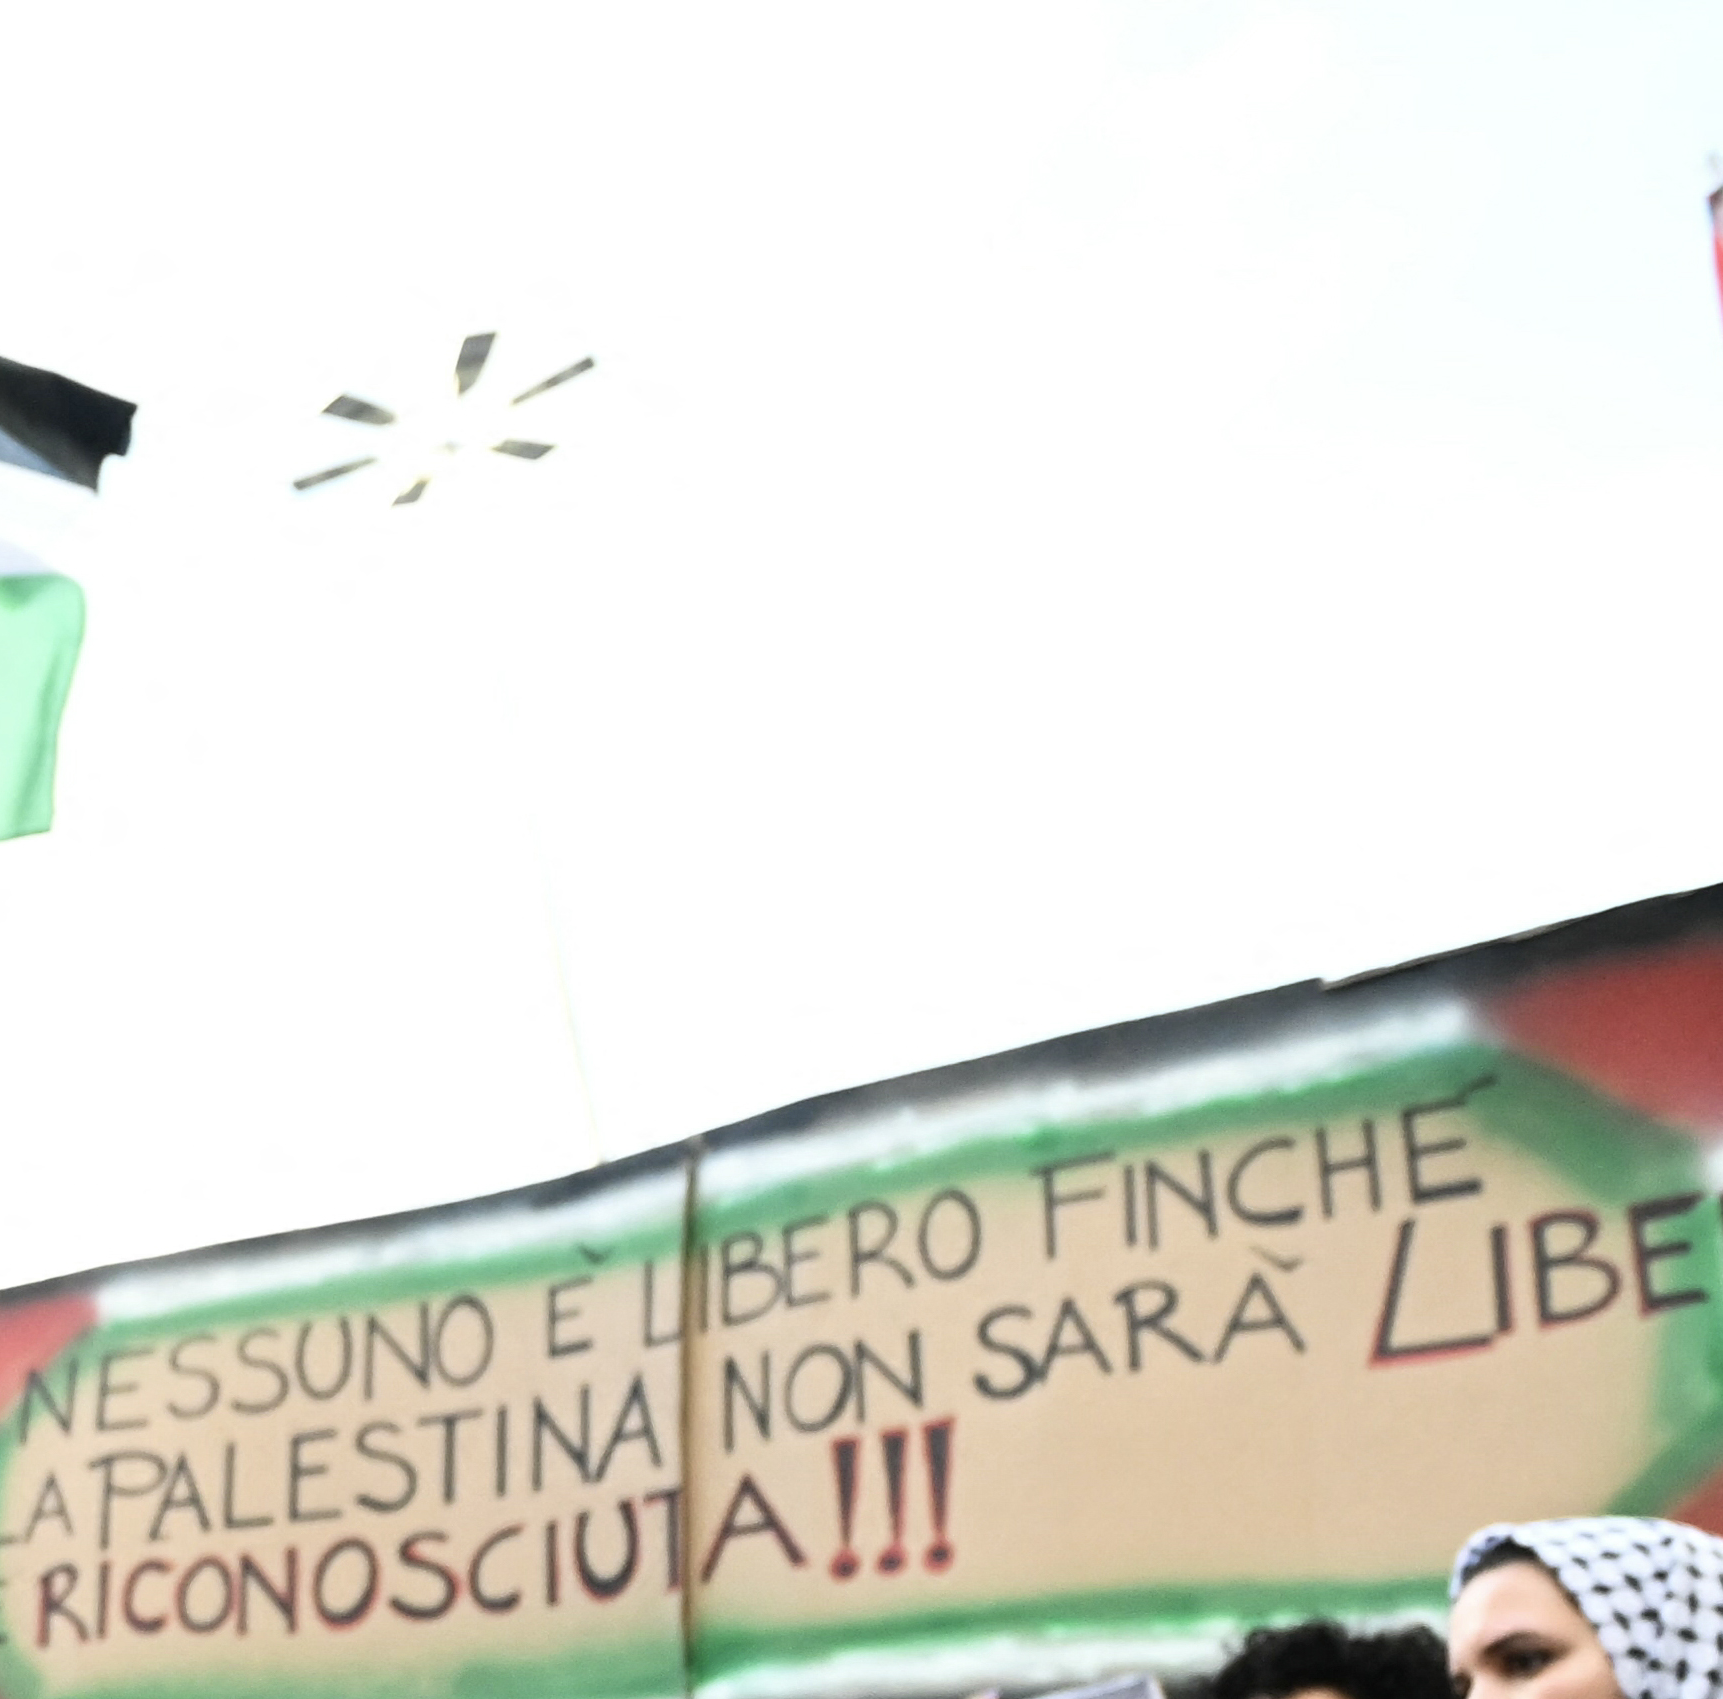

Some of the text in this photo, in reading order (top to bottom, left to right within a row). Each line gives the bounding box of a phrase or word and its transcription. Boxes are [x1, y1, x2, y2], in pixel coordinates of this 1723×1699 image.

[17, 1293, 495, 1445] NESSUNO
[644, 1188, 982, 1348] LIBERO
[90, 1371, 662, 1551] PALESTINA
[723, 1327, 925, 1452] NON
[1367, 1191, 1723, 1367] LIBE
